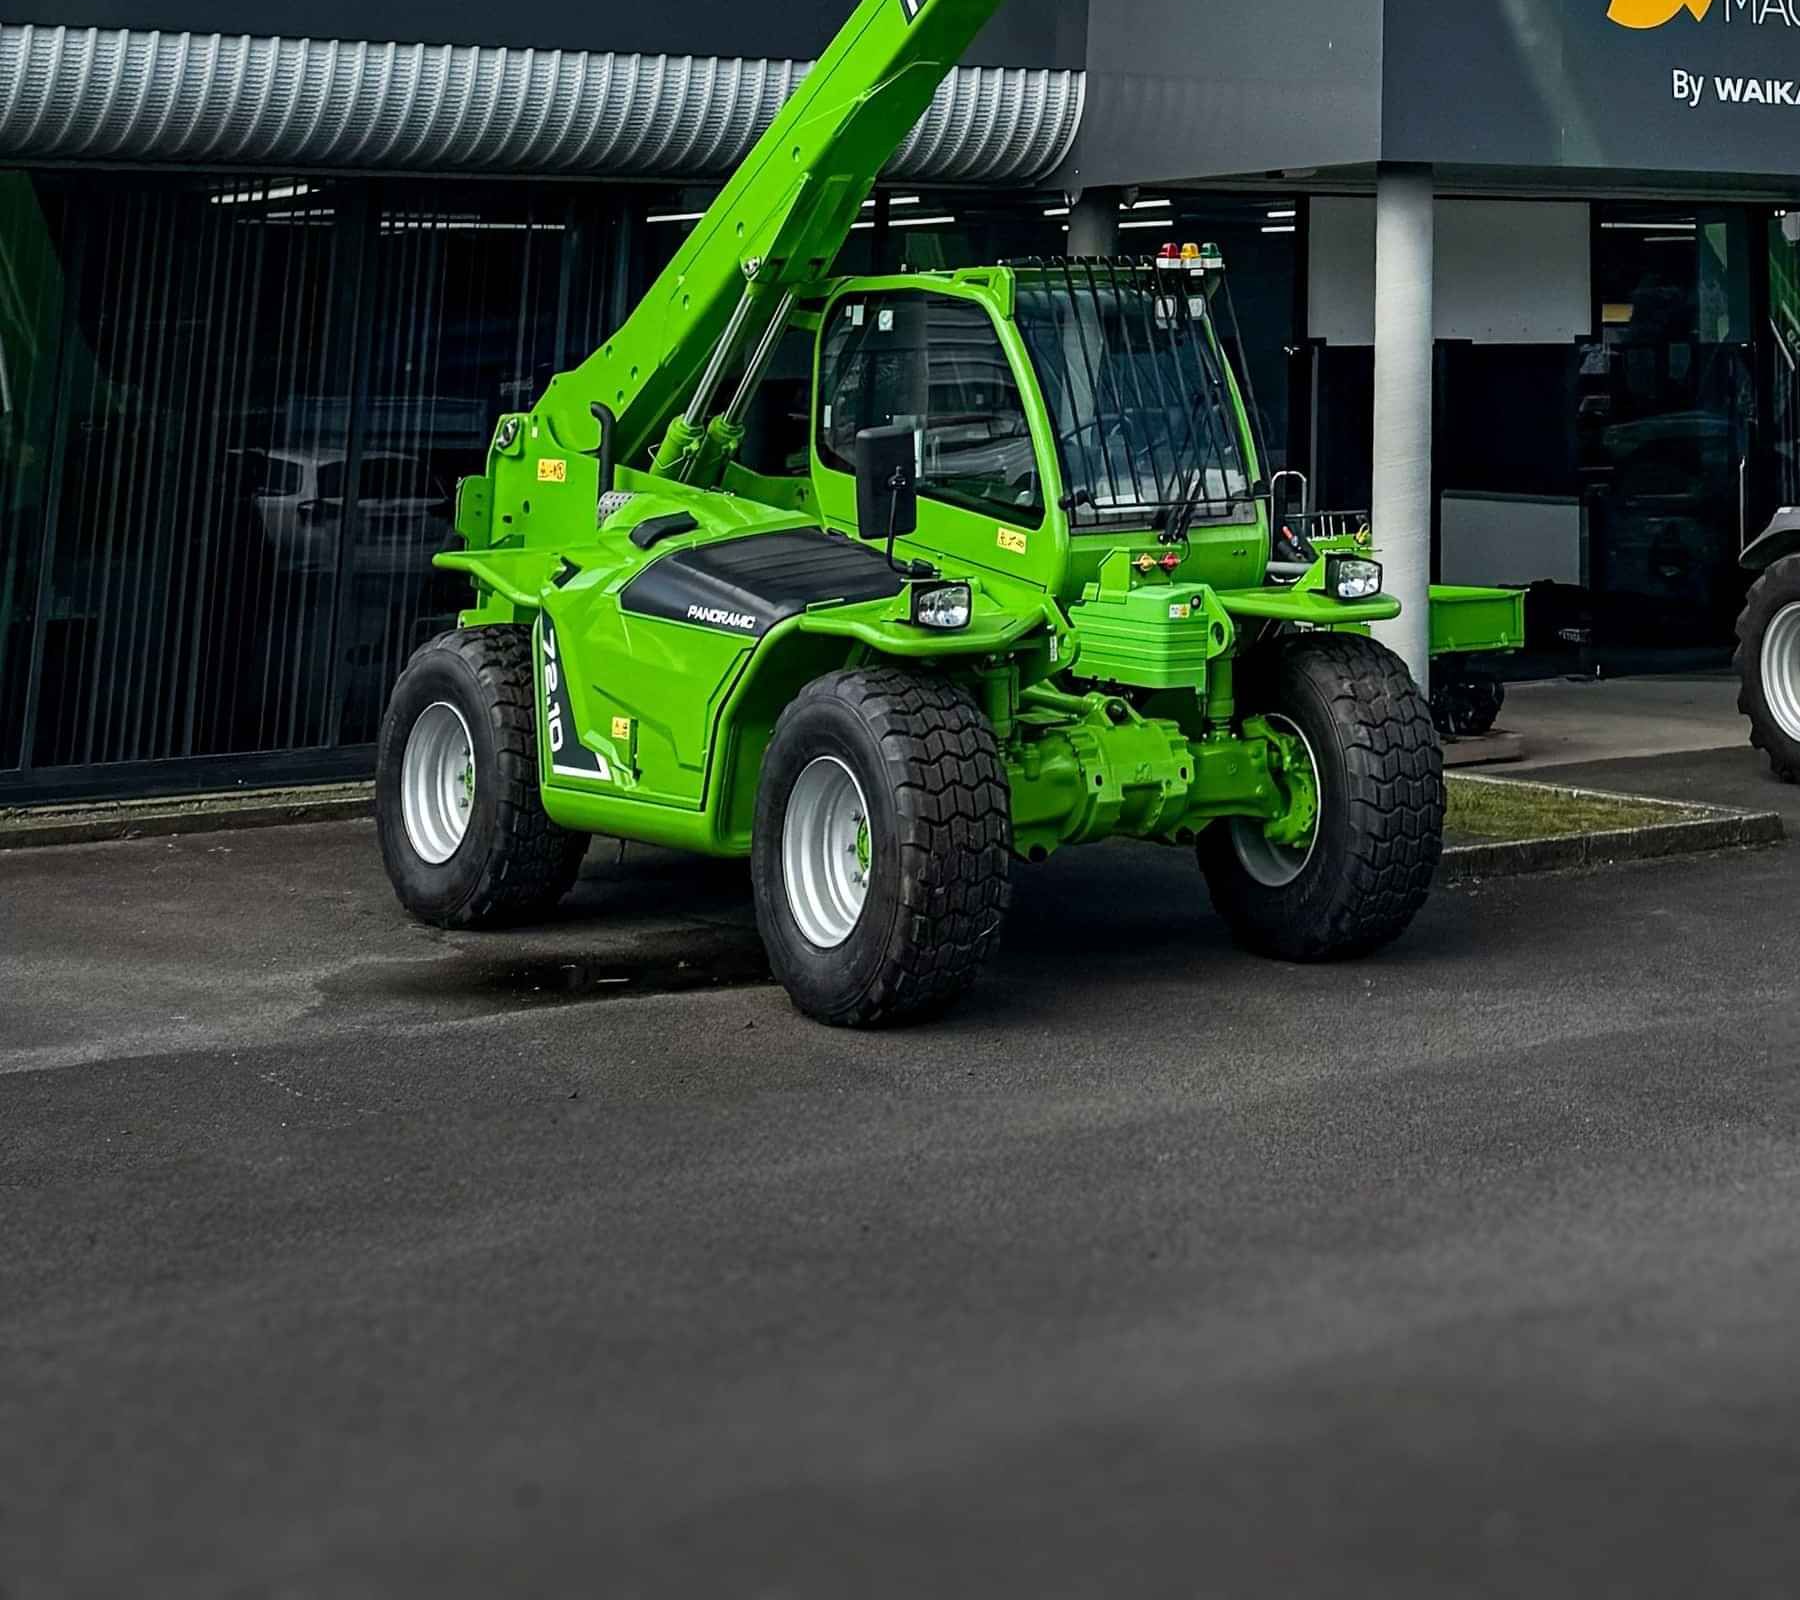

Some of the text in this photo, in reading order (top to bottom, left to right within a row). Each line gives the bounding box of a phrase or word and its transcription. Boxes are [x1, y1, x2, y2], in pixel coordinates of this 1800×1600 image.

[1672, 69, 1704, 108] By
[687, 604, 756, 629] PANORAMIC
[542, 627, 564, 753] 72.10
